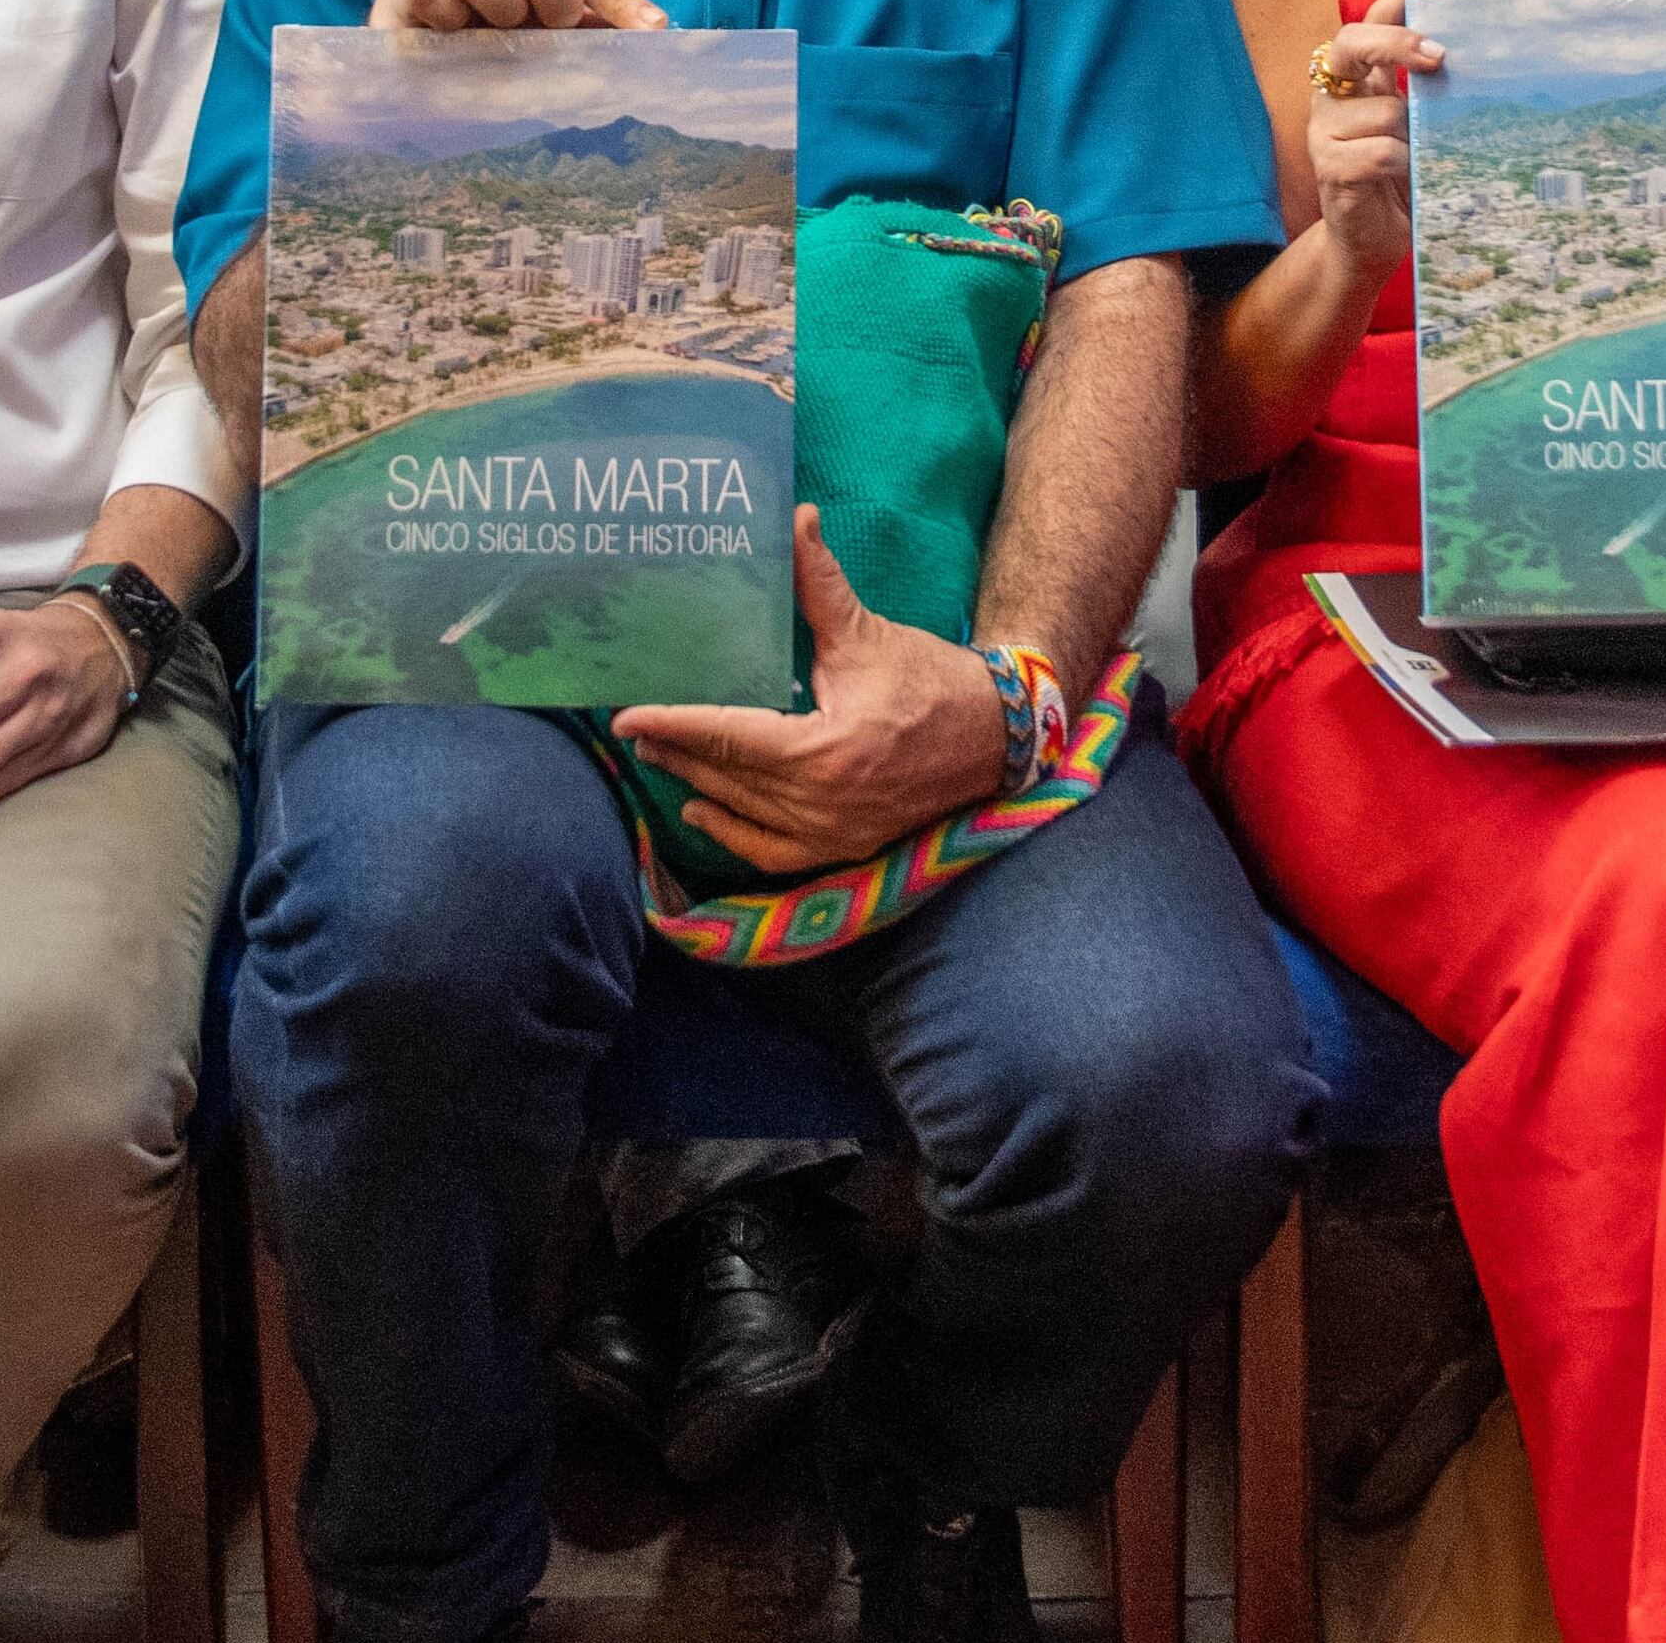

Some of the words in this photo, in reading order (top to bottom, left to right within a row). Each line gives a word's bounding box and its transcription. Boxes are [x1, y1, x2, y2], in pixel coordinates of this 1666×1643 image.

[1544, 441, 1625, 470] CINCO
[386, 454, 556, 512] SANTA
[574, 456, 753, 514] MARTA
[386, 521, 469, 554] CINCO
[477, 521, 576, 554] SIGLOS
[584, 523, 620, 555] DE
[629, 524, 752, 556] HISTORIA
